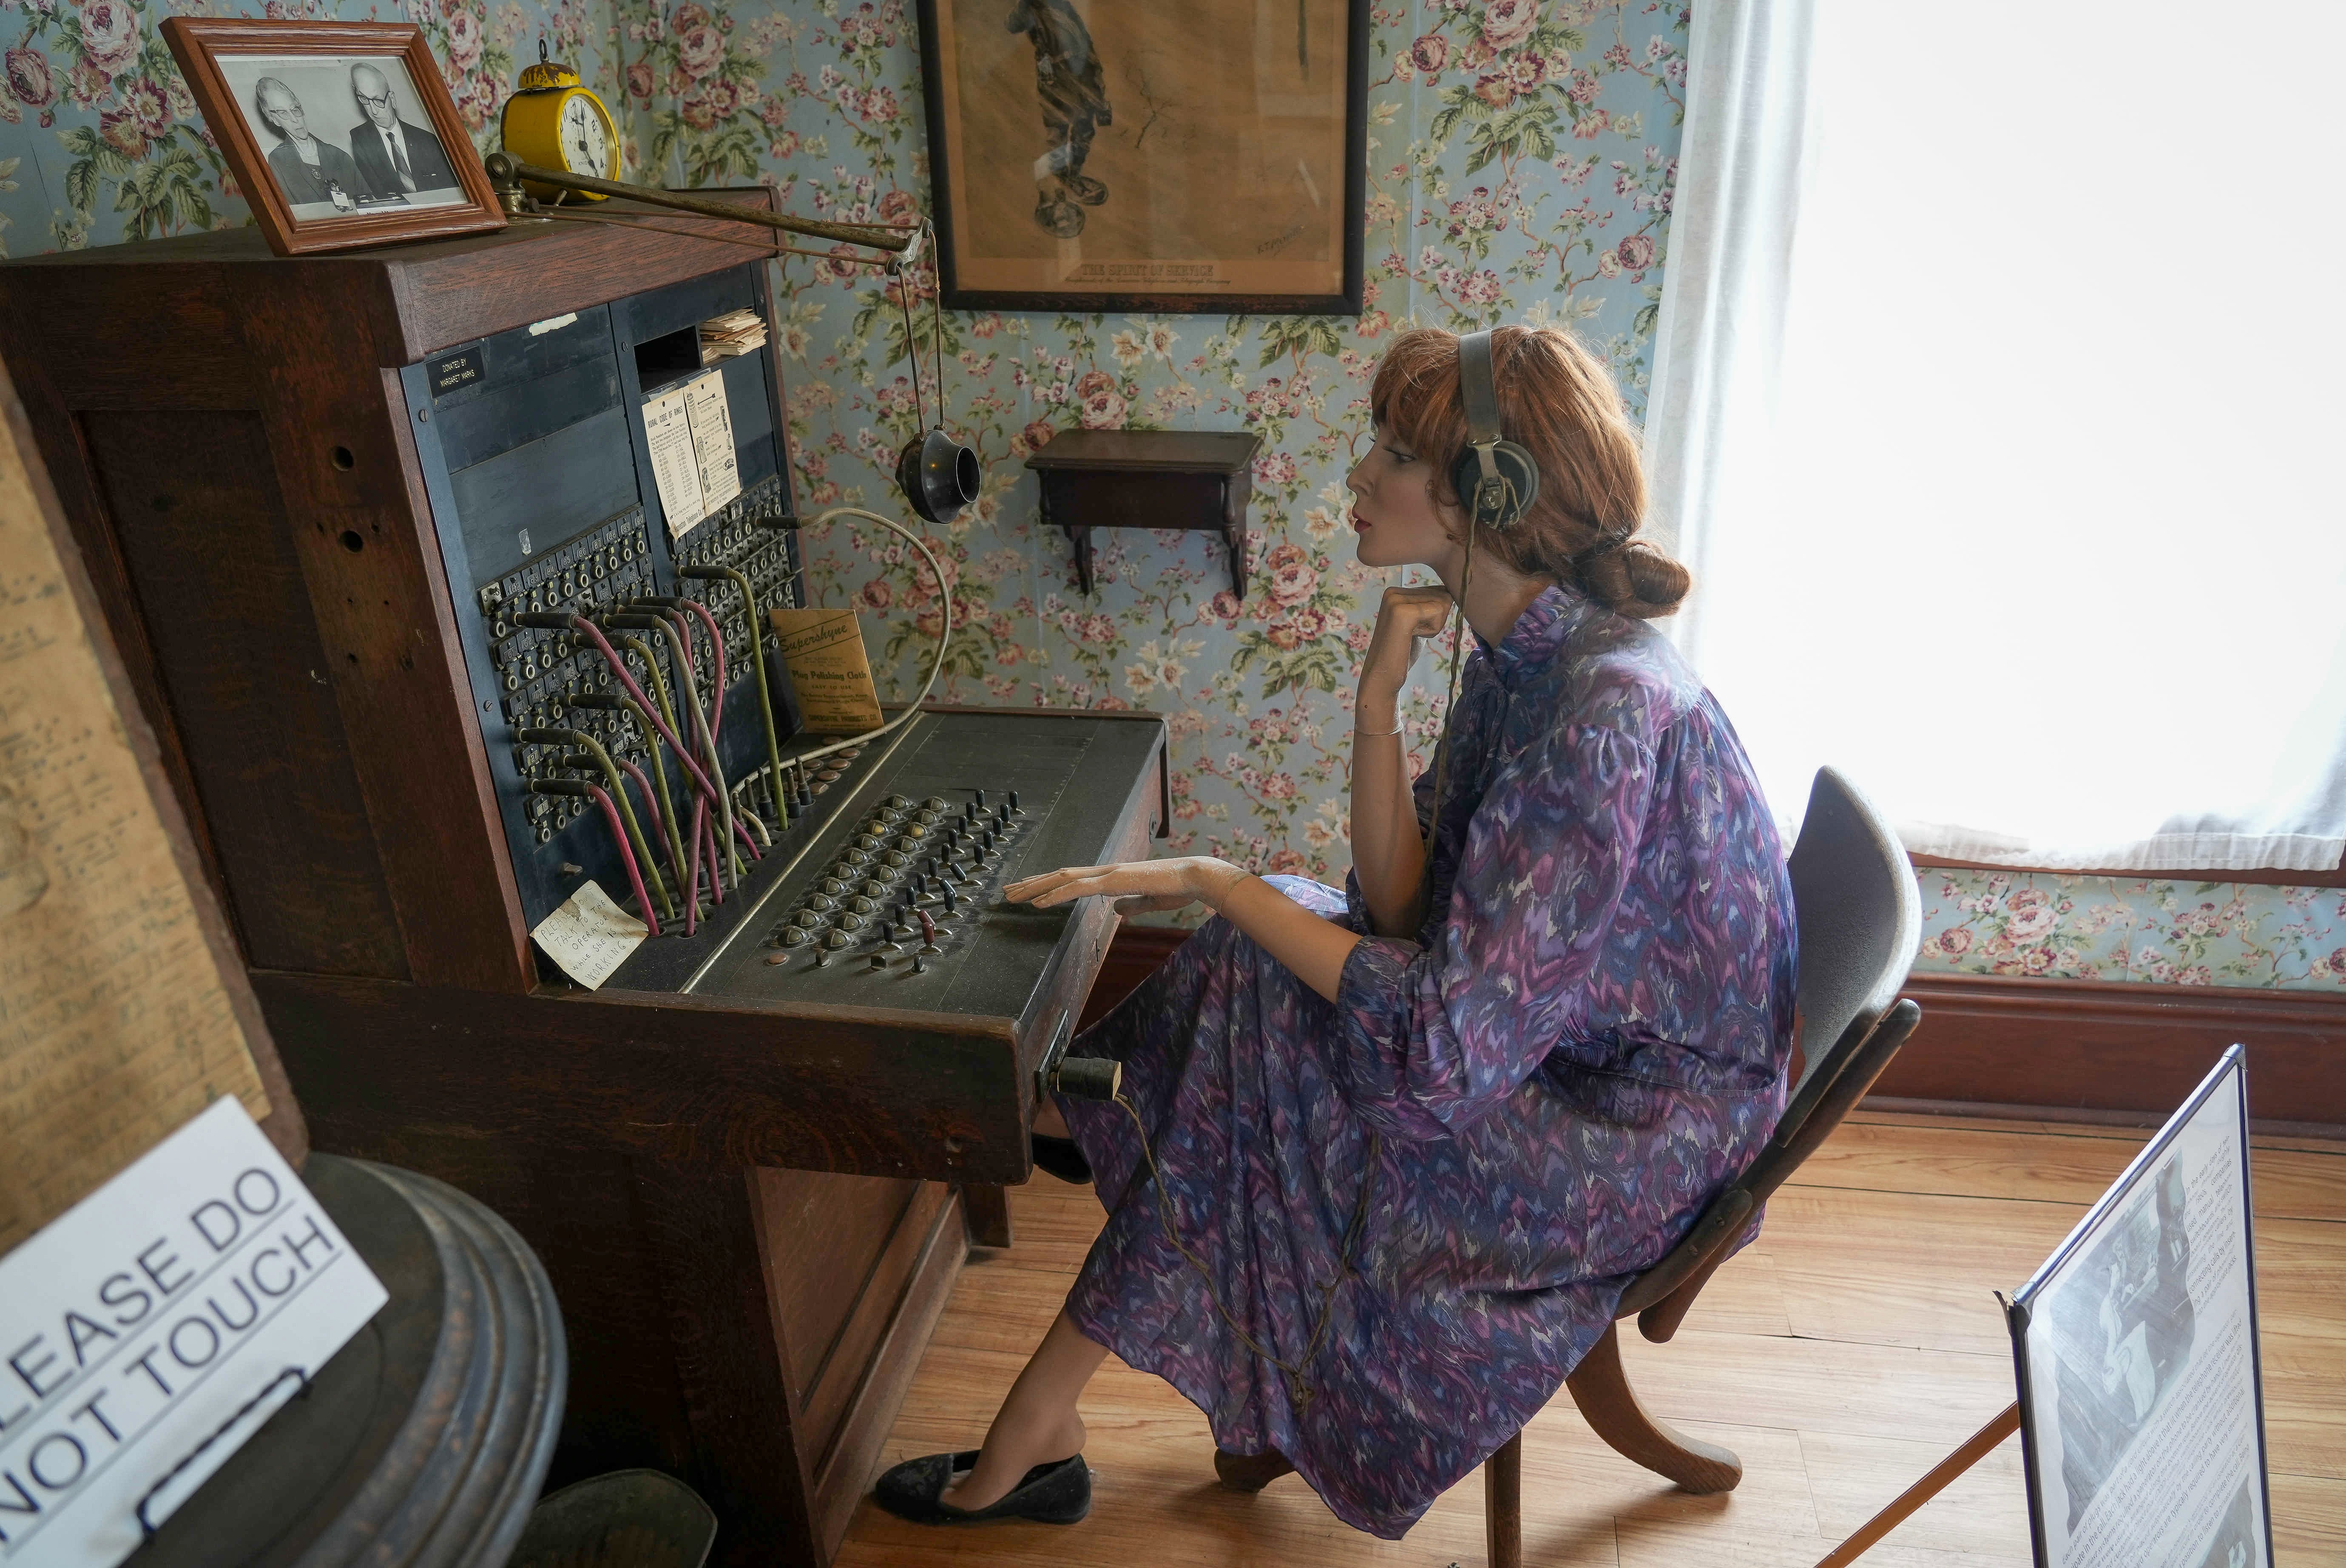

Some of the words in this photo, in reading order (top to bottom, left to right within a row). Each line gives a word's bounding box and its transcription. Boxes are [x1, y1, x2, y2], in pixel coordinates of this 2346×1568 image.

[1082, 264, 1105, 276] THE
[1108, 264, 1147, 276] SPIRIT
[1150, 264, 1163, 276] OF
[1167, 264, 1213, 276] SERVICE
[440, 374, 460, 388] MARGARET
[461, 369, 475, 380] MARKS
[442, 361, 460, 372] DONATED
[461, 358, 466, 366] BY
[648, 418, 658, 429] RURAL
[659, 412, 667, 423] CODE
[669, 410, 673, 418] OF
[674, 406, 683, 416] RINGS
[563, 556, 571, 566] 85
[779, 624, 848, 653] Supershyne
[792, 670, 808, 681] Plug
[810, 670, 845, 681] Polishing
[846, 670, 866, 679] Cloth
[554, 925, 578, 947] TALK
[578, 916, 588, 927] TO
[590, 899, 606, 914] THE
[572, 915, 609, 950] OPERATOR
[570, 953, 591, 971] WHILE
[592, 938, 606, 952] SHE
[607, 928, 616, 938] IS
[2211, 1159, 2232, 1186] companies
[190, 1167, 281, 1253] DO
[2186, 1217, 2198, 1233] used
[2198, 1194, 2214, 1219] manual
[2189, 1263, 2212, 1294] connecting
[2211, 1250, 2220, 1266] calls
[0, 1388, 121, 1542] NOT
[124, 1214, 335, 1395] TOUCH
[2085, 1541, 2091, 1554] in
[2089, 1531, 2099, 1546] the
[2105, 1503, 2116, 1521] Each
[2123, 1476, 2133, 1494] had
[2135, 1457, 2147, 1475] light
[2146, 1440, 2159, 1461] above
[2159, 1433, 2163, 1443] it
[2161, 1421, 2173, 1439] that
[2174, 1400, 2187, 1419] when
[2185, 1390, 2193, 1403] the
[2192, 1363, 2213, 1395] telephone
[2211, 1341, 2227, 1367] receiver
[2224, 1332, 2235, 1346] was
[2211, 1414, 2227, 1437] without
[2115, 1496, 2134, 1528] required
[2136, 1466, 2157, 1498] generator
[2156, 1456, 2163, 1468] on
[2161, 1446, 2169, 1459] the
[2169, 1427, 2183, 1449] phone
[2143, 1525, 2164, 1559] operators
[2170, 1489, 2189, 1519] typically
[2187, 1464, 2205, 1492] required
[2204, 1458, 2210, 1469] to
[2209, 1444, 2220, 1461] have
[2218, 1431, 2229, 1446] very
[2210, 1478, 2227, 1508] complete
[2225, 1469, 2234, 1482] the
[2062, 1545, 2073, 1565] Each
[2073, 1532, 2083, 1551] pair
[2088, 1506, 2102, 1529] plugs
[2180, 1540, 2200, 1568] position
[2197, 1532, 2204, 1543] to
[2201, 1516, 2215, 1535] listen
[2214, 1510, 2219, 1519] to
